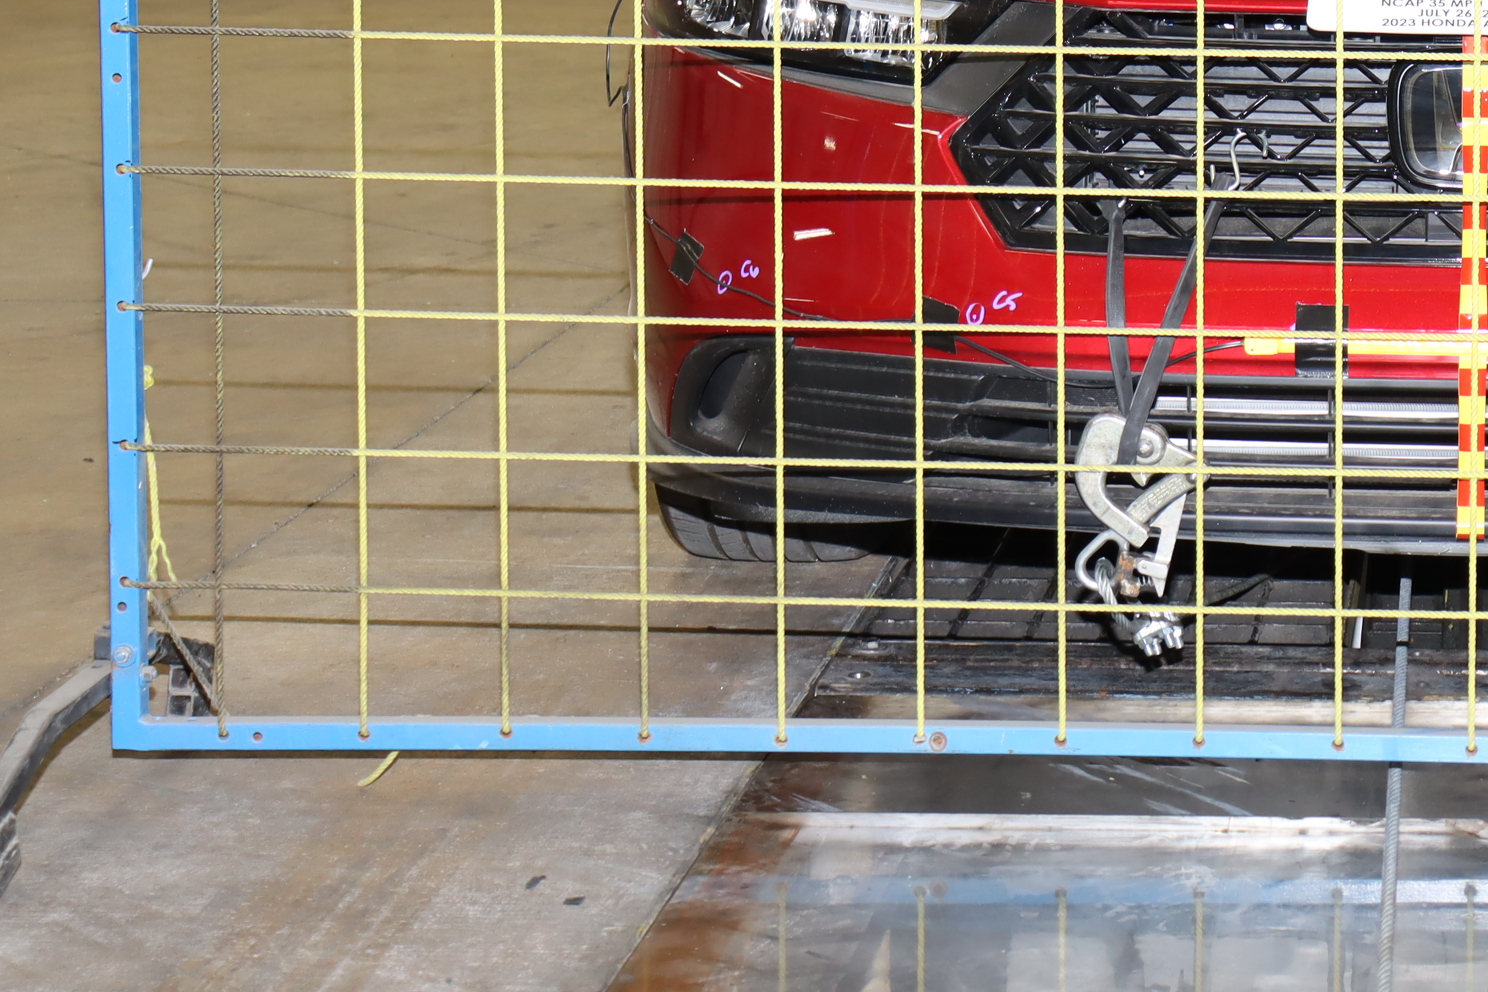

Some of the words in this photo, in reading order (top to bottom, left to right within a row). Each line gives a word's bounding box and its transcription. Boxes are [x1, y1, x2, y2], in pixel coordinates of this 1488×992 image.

[1429, 0, 1446, 7] 35
[1418, 9, 1450, 18] JULY
[1381, 18, 1416, 27] 2023
